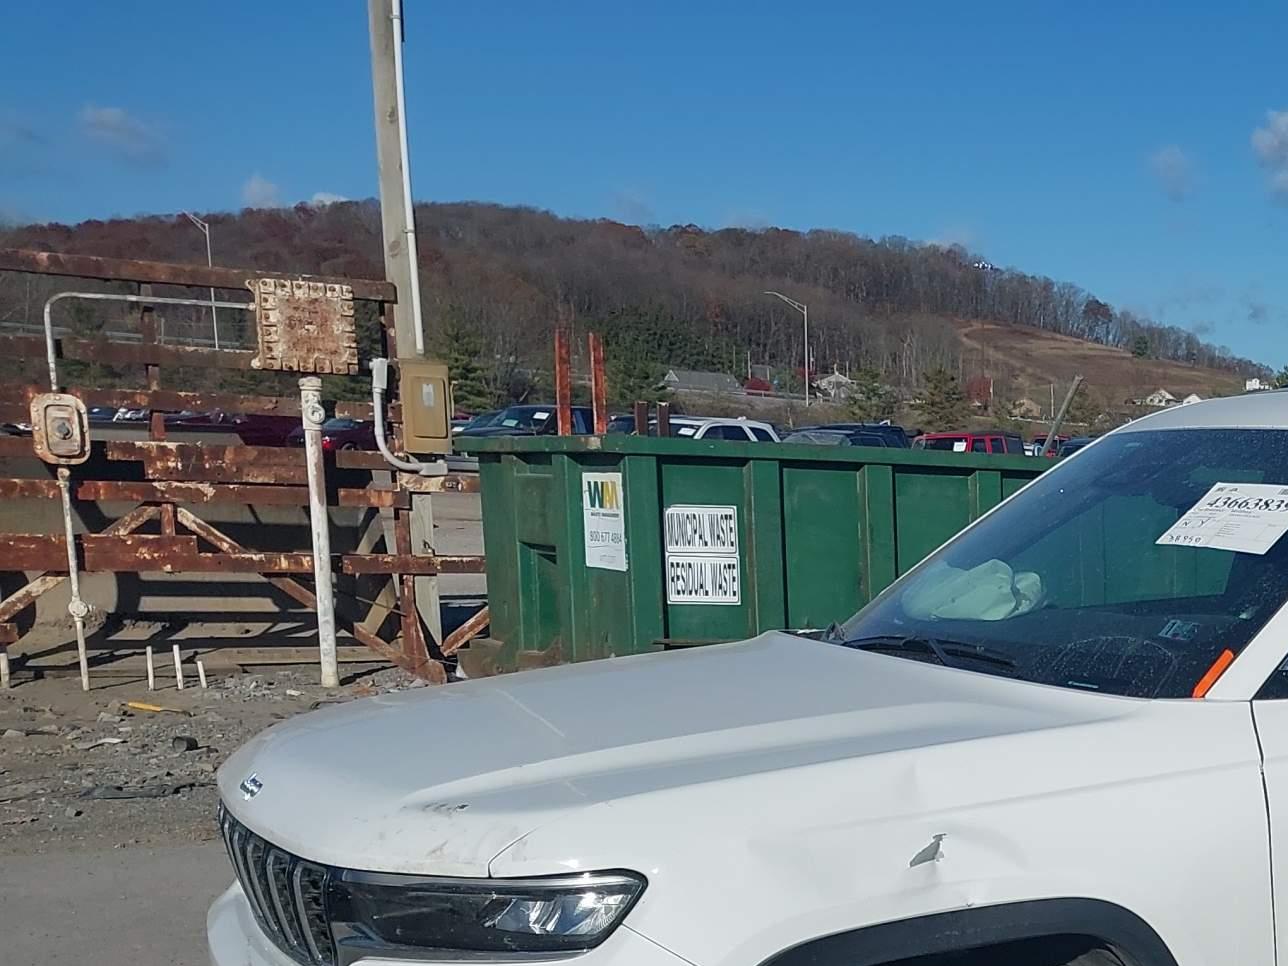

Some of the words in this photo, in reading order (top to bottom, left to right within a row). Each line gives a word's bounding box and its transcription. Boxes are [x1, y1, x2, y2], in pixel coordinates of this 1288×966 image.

[587, 481, 619, 509] WM
[667, 512, 708, 547] MUNICIPAL
[708, 513, 735, 547] WASTE
[670, 562, 709, 597] RESIDUAL
[710, 563, 737, 597] WASTE
